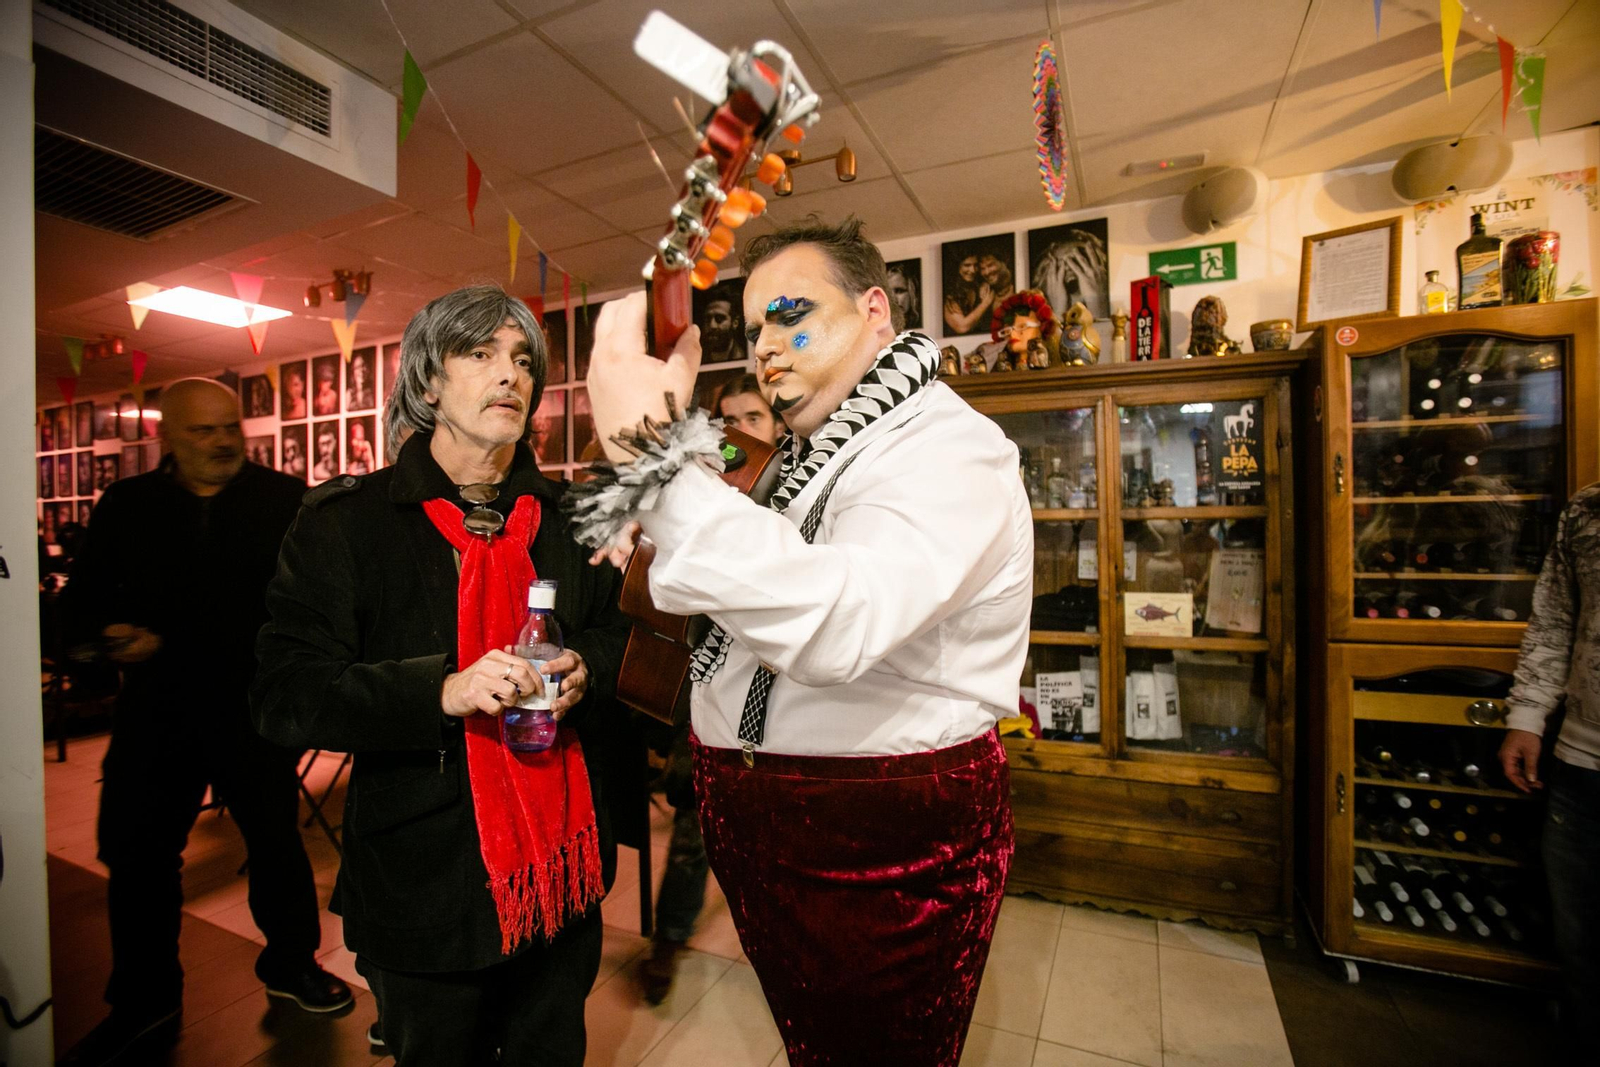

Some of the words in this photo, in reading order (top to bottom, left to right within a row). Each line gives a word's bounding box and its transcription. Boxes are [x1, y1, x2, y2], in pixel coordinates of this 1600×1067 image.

[1470, 198, 1535, 214] WINT
[1231, 444, 1249, 456] LA
[1222, 456, 1258, 469] PEPA
